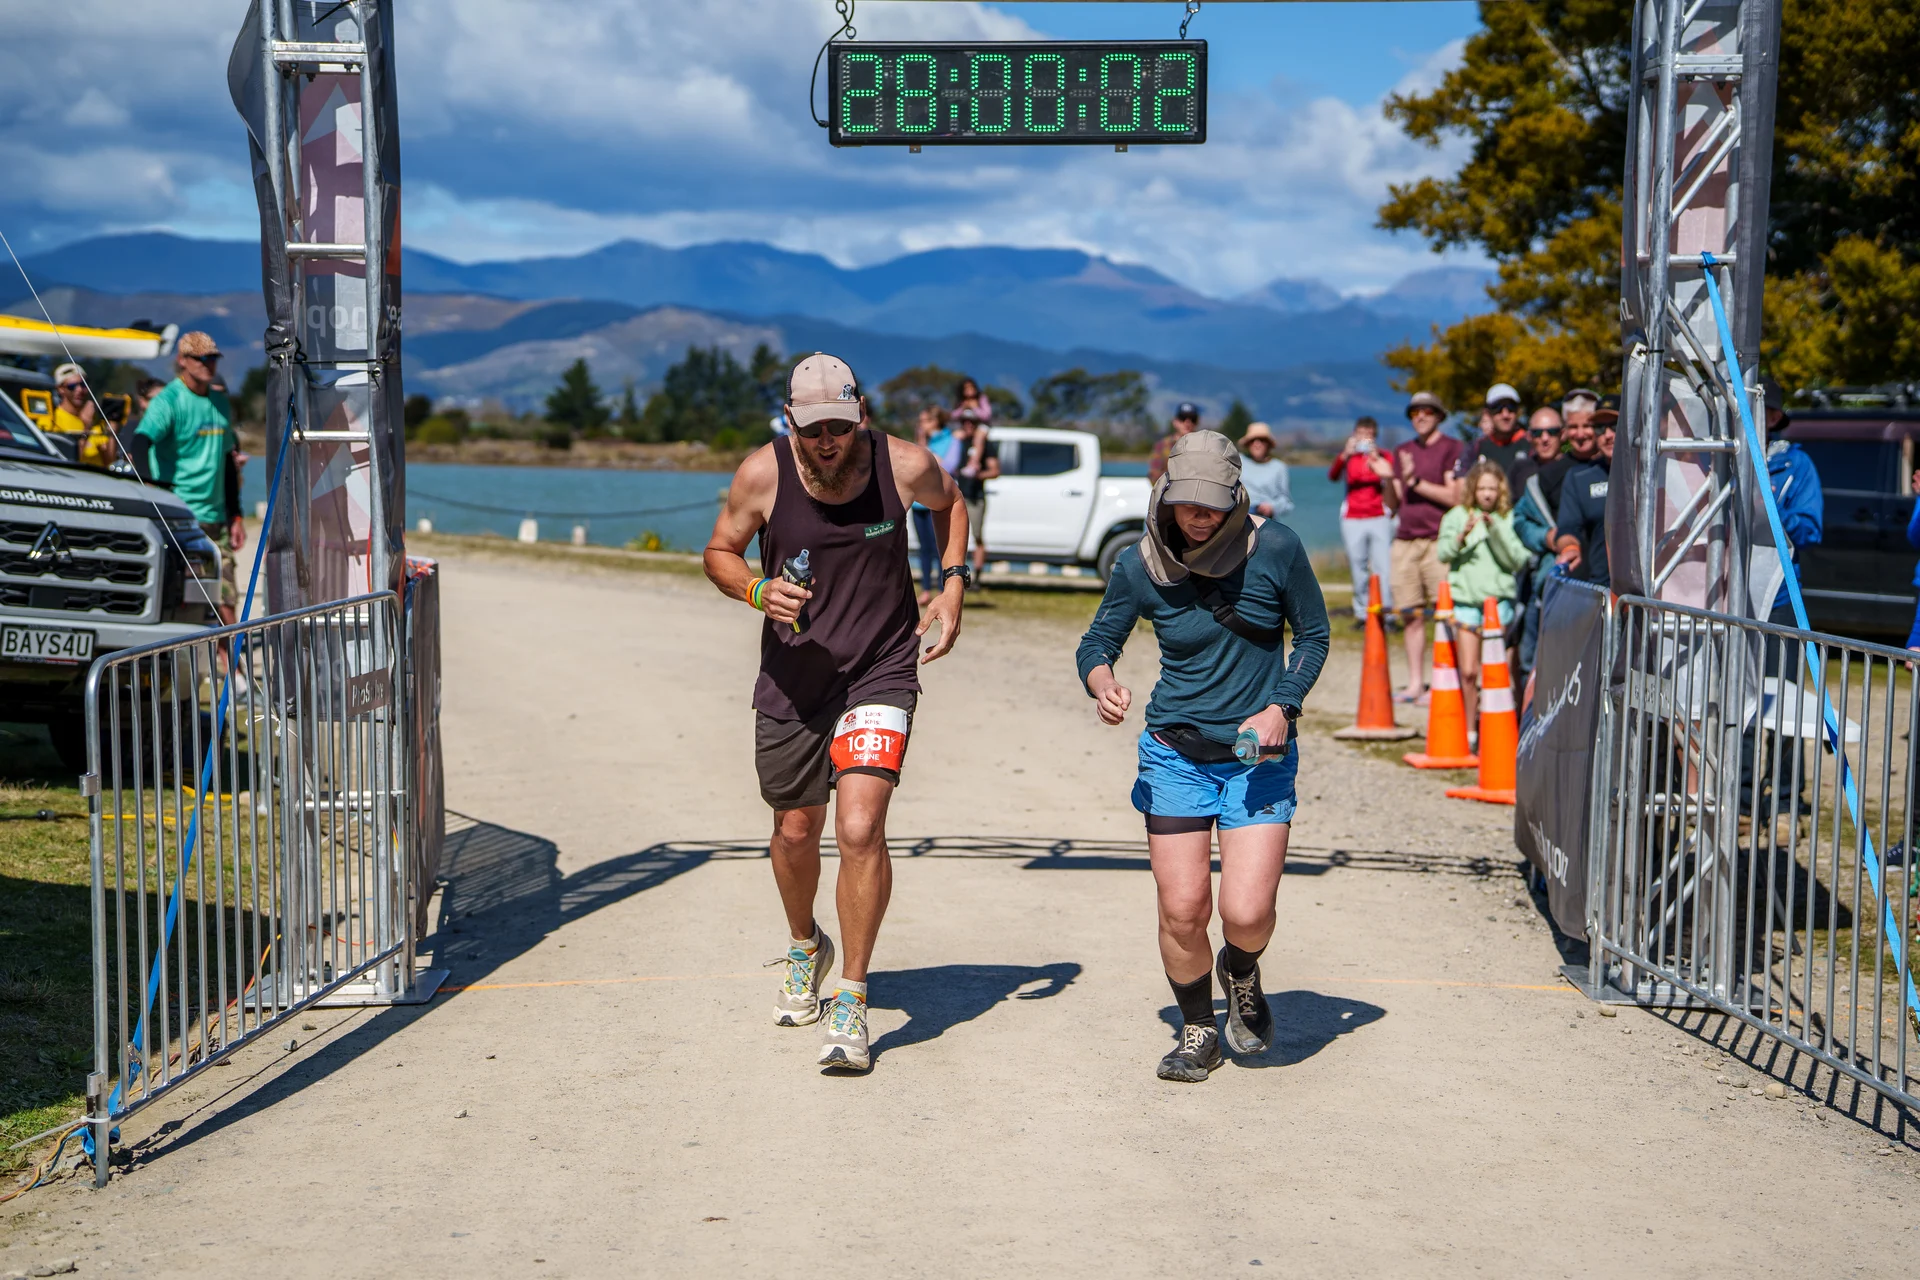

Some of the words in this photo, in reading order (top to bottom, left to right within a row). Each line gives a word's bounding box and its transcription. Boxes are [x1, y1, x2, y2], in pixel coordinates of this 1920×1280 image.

[842, 53, 1196, 133] 28:00:02
[0, 489, 114, 511] andaman.nz
[5, 630, 90, 657] BAYS4U
[847, 734, 890, 753] 1081
